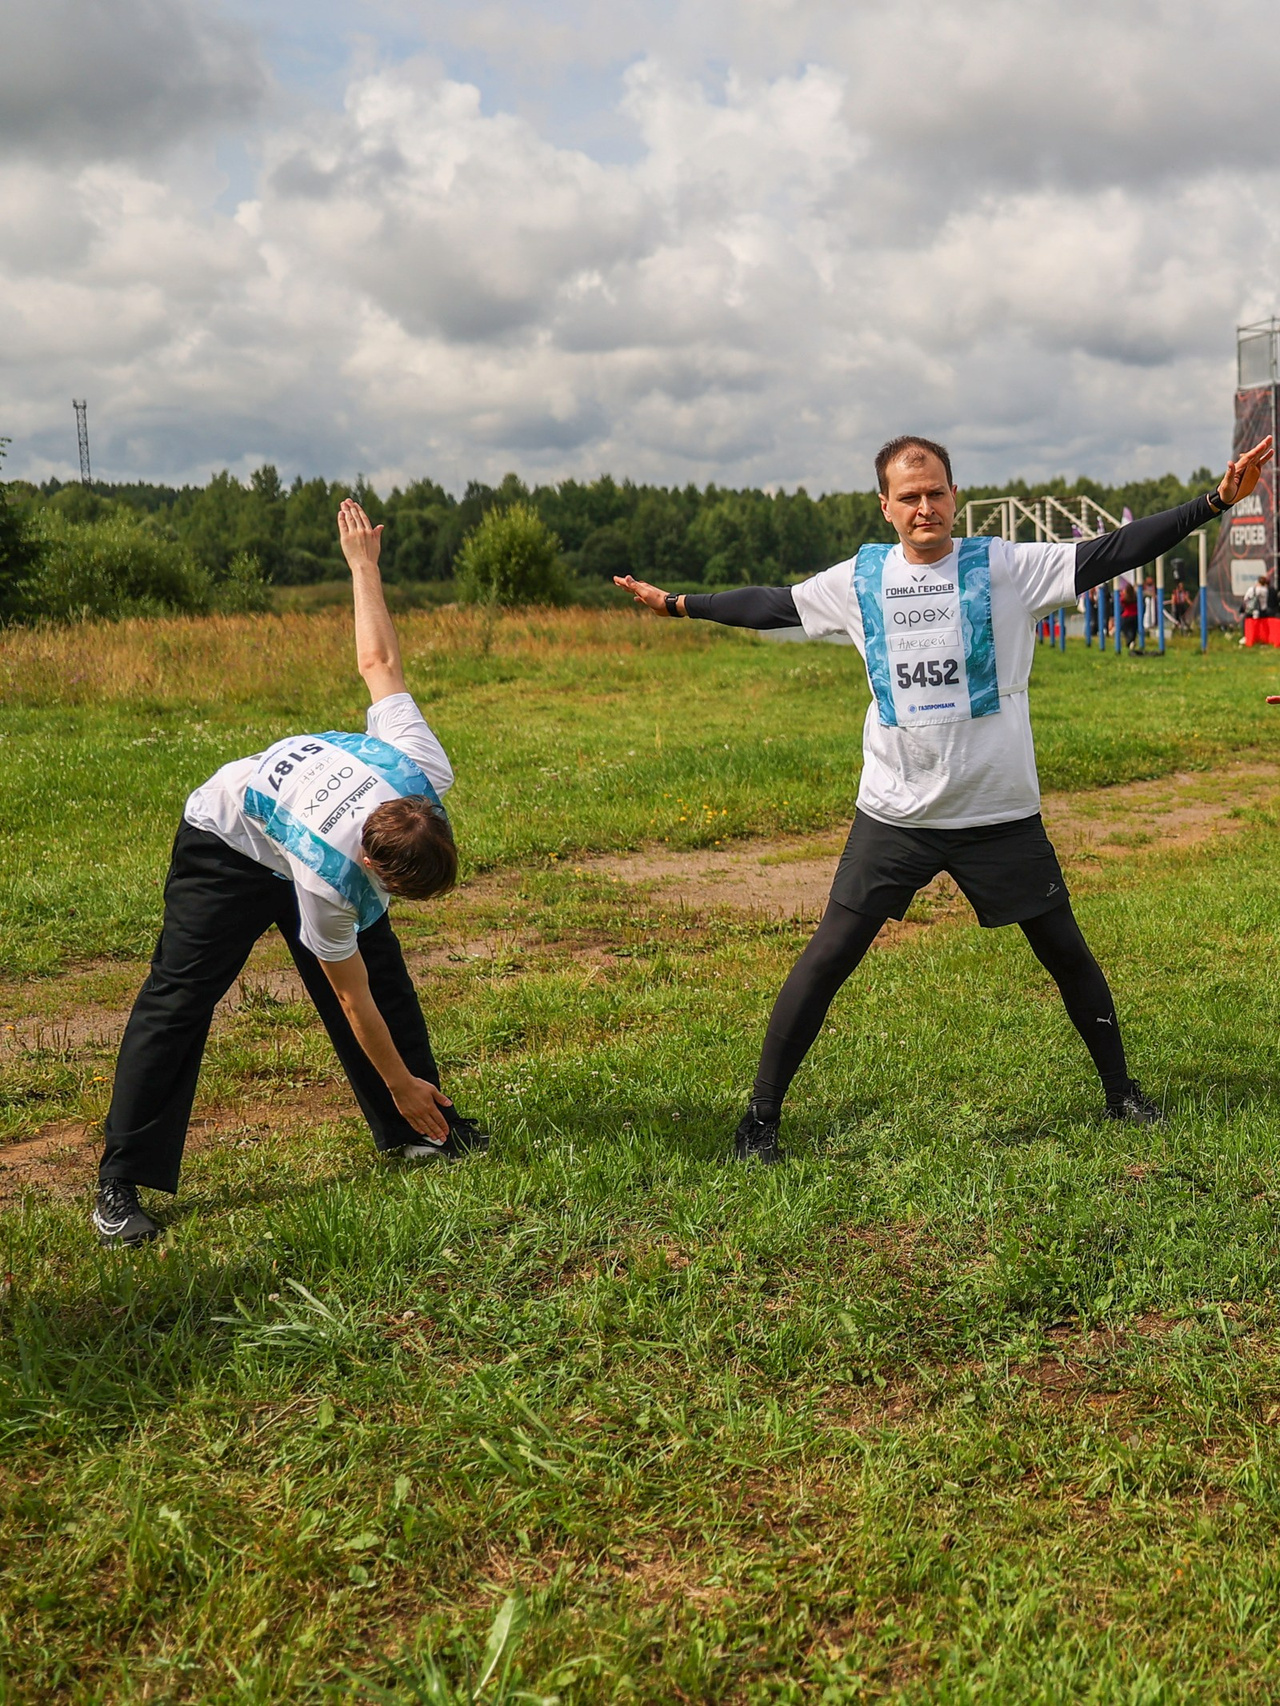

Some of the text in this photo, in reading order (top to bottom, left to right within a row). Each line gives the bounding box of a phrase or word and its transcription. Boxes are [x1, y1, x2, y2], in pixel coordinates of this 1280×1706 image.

[1230, 525, 1266, 546] ГЕРОЕВ
[886, 583, 955, 596] ГОНКА ГЕРОЕВ
[898, 633, 946, 649] Алексей
[896, 658, 960, 689] 5452
[918, 702, 956, 711] ГАЗПРОМБАНК
[268, 743, 324, 792] 5187
[320, 777, 379, 835] ГОНКА ГЕРОЕВ
